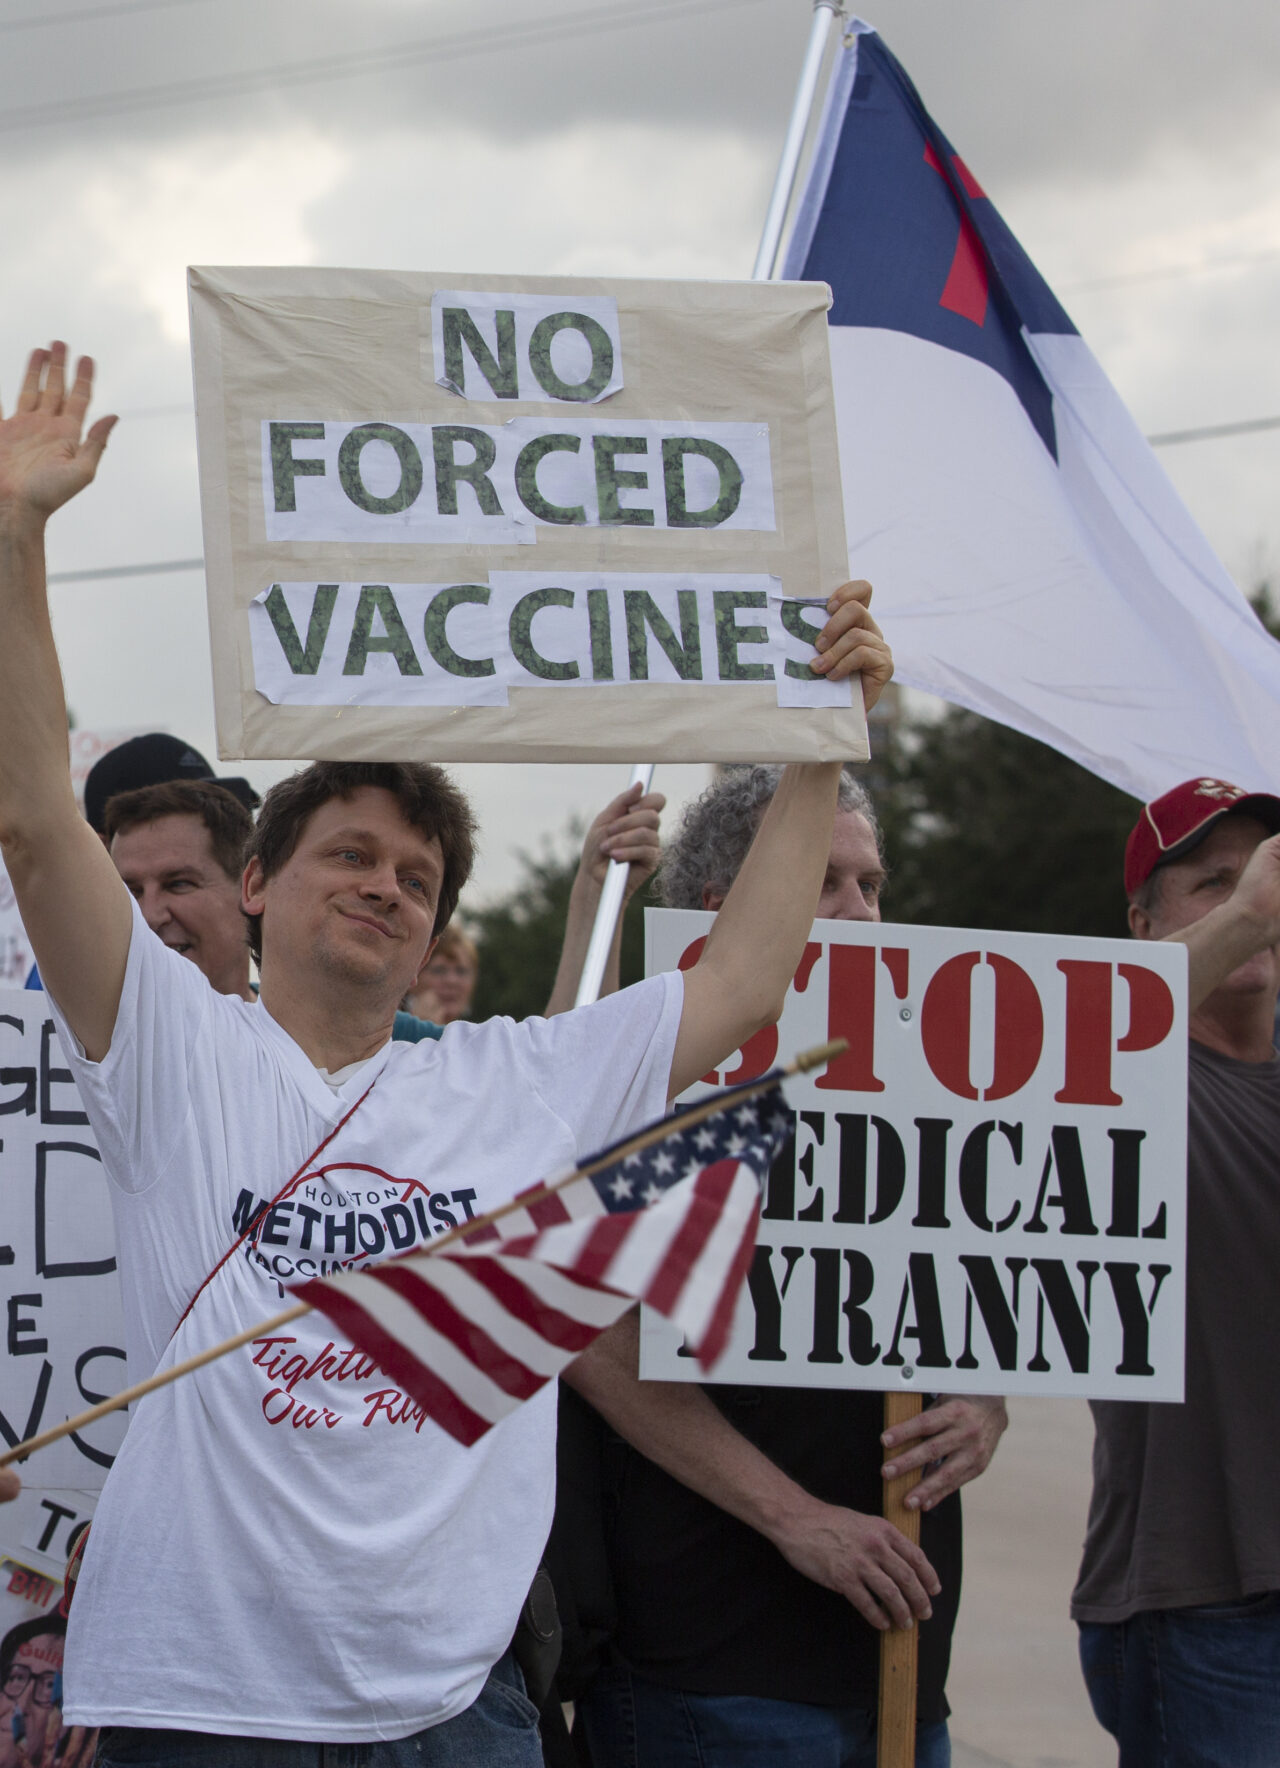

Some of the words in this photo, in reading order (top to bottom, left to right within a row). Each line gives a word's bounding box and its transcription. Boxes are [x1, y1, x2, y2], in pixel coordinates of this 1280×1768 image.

[442, 307, 614, 402] NO
[269, 422, 744, 529] FORCED
[264, 584, 832, 682] VACCINES
[675, 1102, 1167, 1240] EDICAL
[231, 1188, 477, 1255] METHODIST
[677, 1245, 1172, 1377] YRANNY
[262, 1388, 344, 1429] Our
[7, 1569, 55, 1608] Bill
